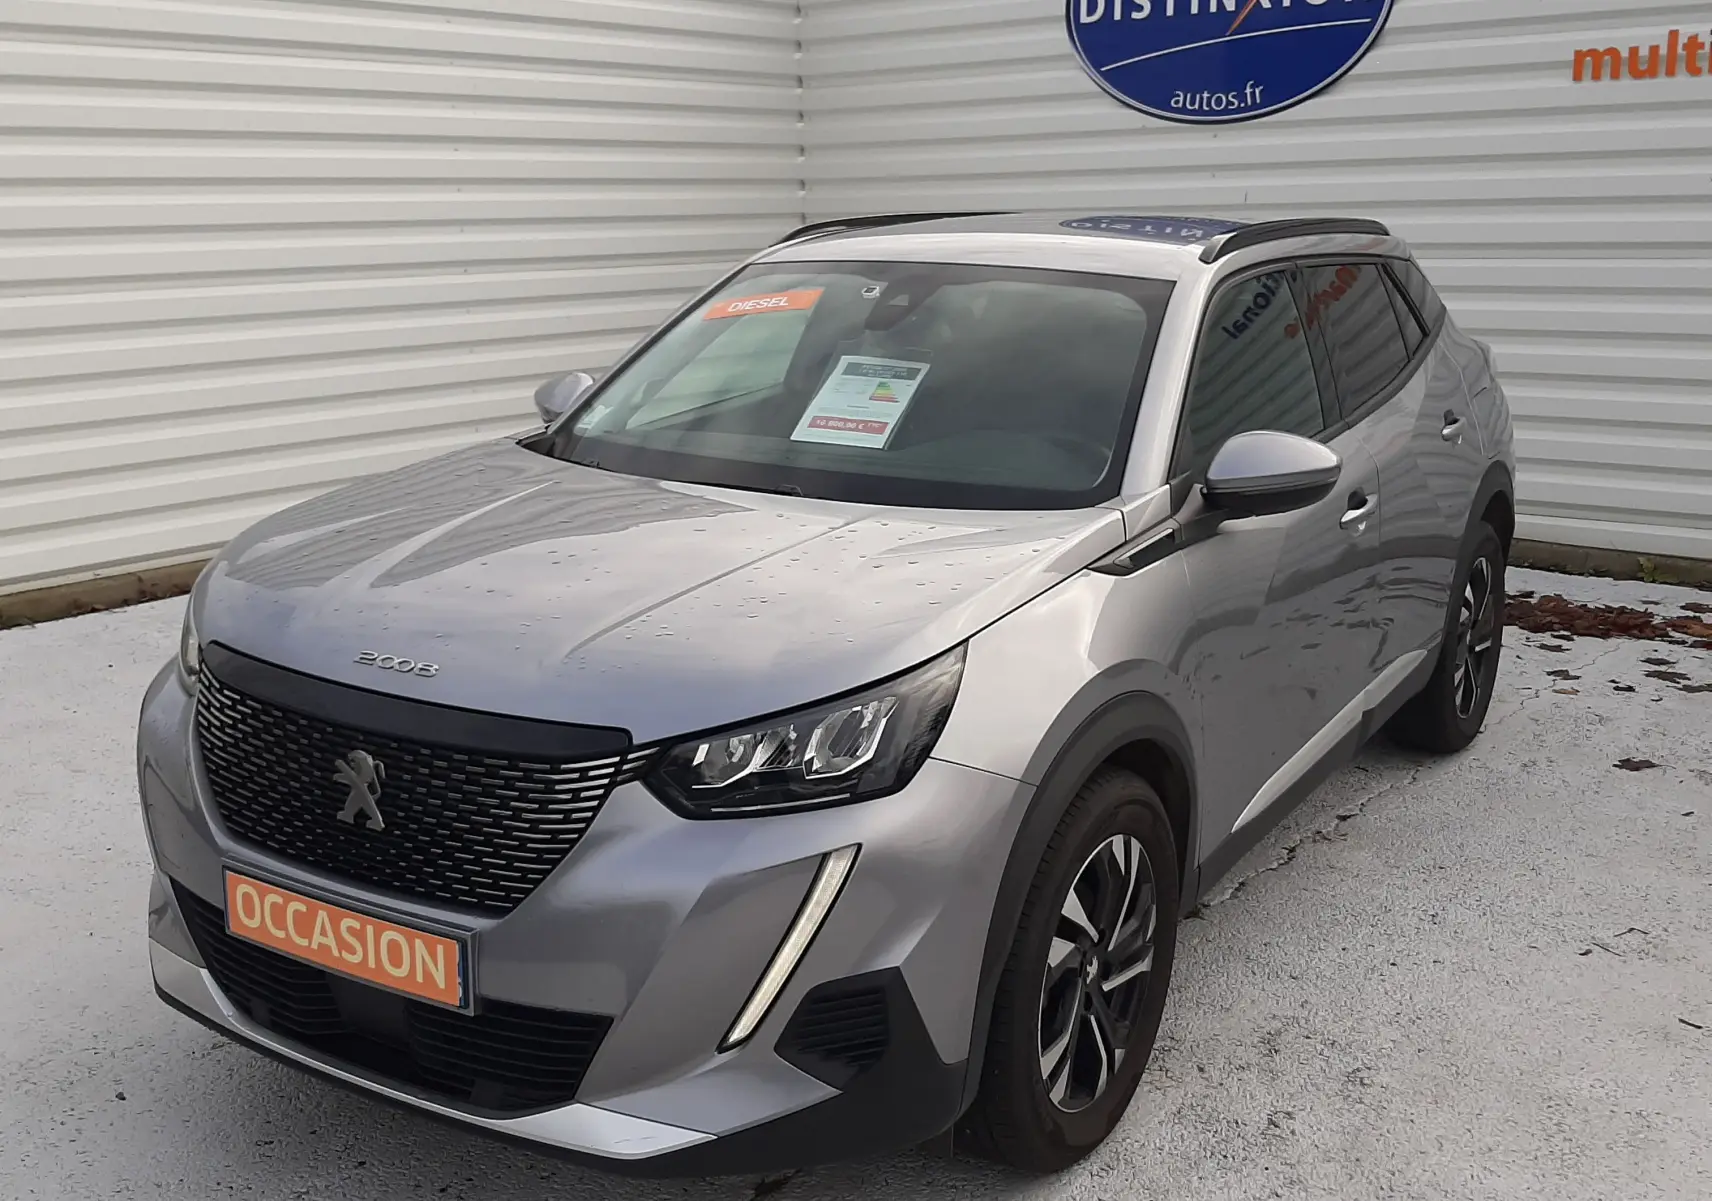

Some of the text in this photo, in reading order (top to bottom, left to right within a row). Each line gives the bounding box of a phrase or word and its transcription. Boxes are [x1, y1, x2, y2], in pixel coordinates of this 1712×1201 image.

[1170, 81, 1264, 110] autos.fr
[727, 296, 789, 312] DIESEL
[353, 650, 440, 678] 2008
[235, 882, 446, 990] OCCASION
